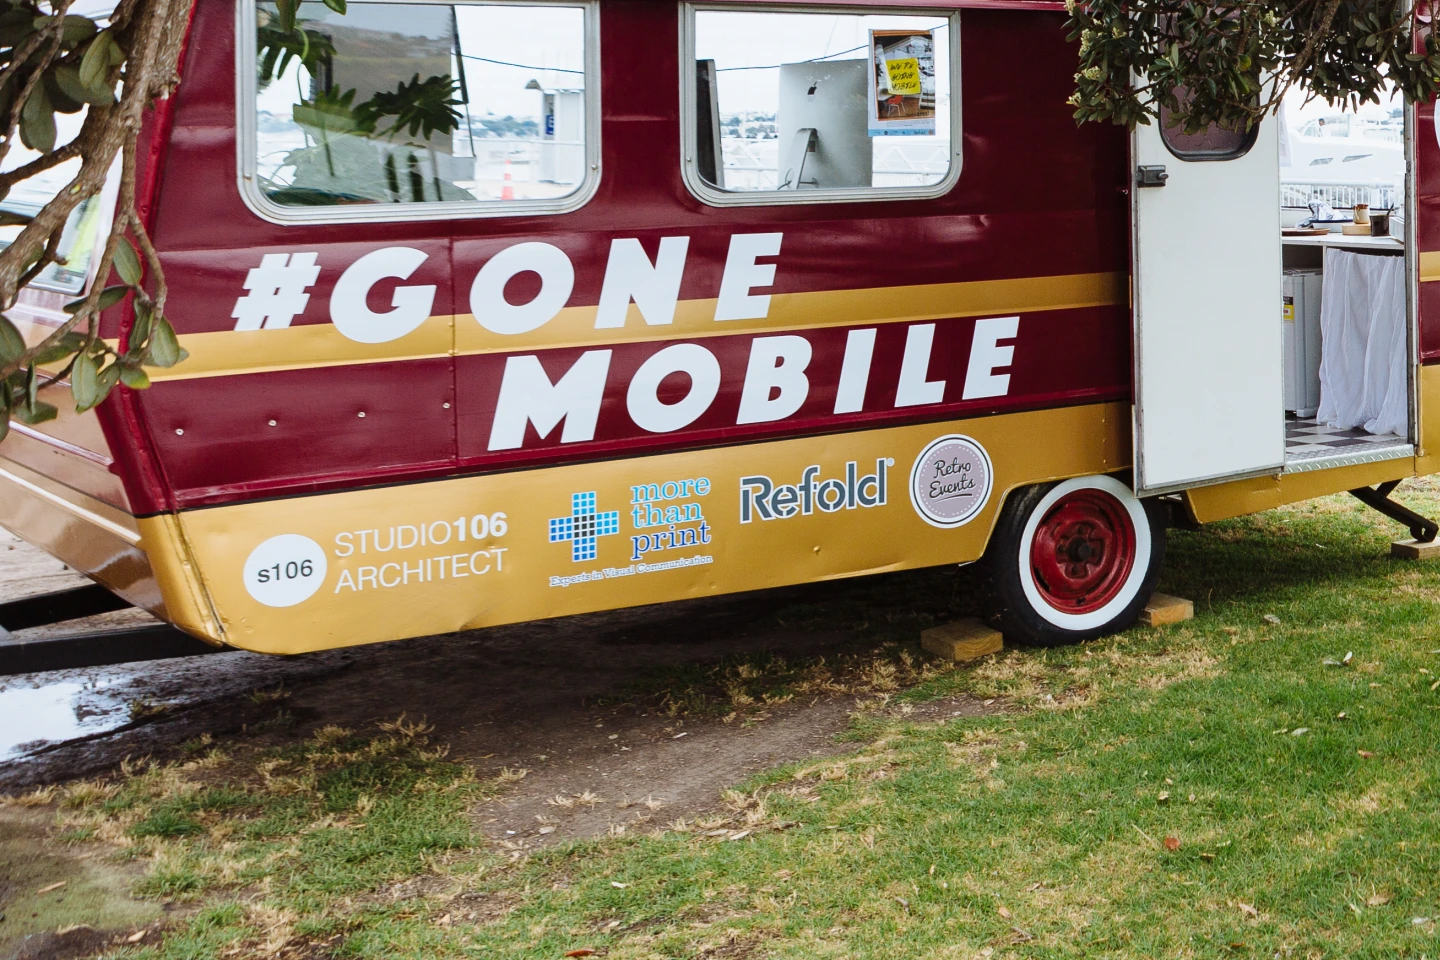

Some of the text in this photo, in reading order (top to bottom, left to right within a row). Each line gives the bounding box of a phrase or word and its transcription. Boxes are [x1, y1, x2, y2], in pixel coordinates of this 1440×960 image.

[231, 232, 784, 344] #GONE
[486, 316, 1021, 452] MOBILE
[933, 456, 972, 480] Retro
[630, 476, 711, 505] more
[929, 473, 977, 499] Events
[631, 502, 704, 528] than
[334, 512, 508, 557] STUDIO106
[630, 520, 712, 561] print
[256, 558, 314, 584] s106
[334, 547, 509, 594] ARCHITECT
[549, 555, 714, 587] Experts in Visual Communication
